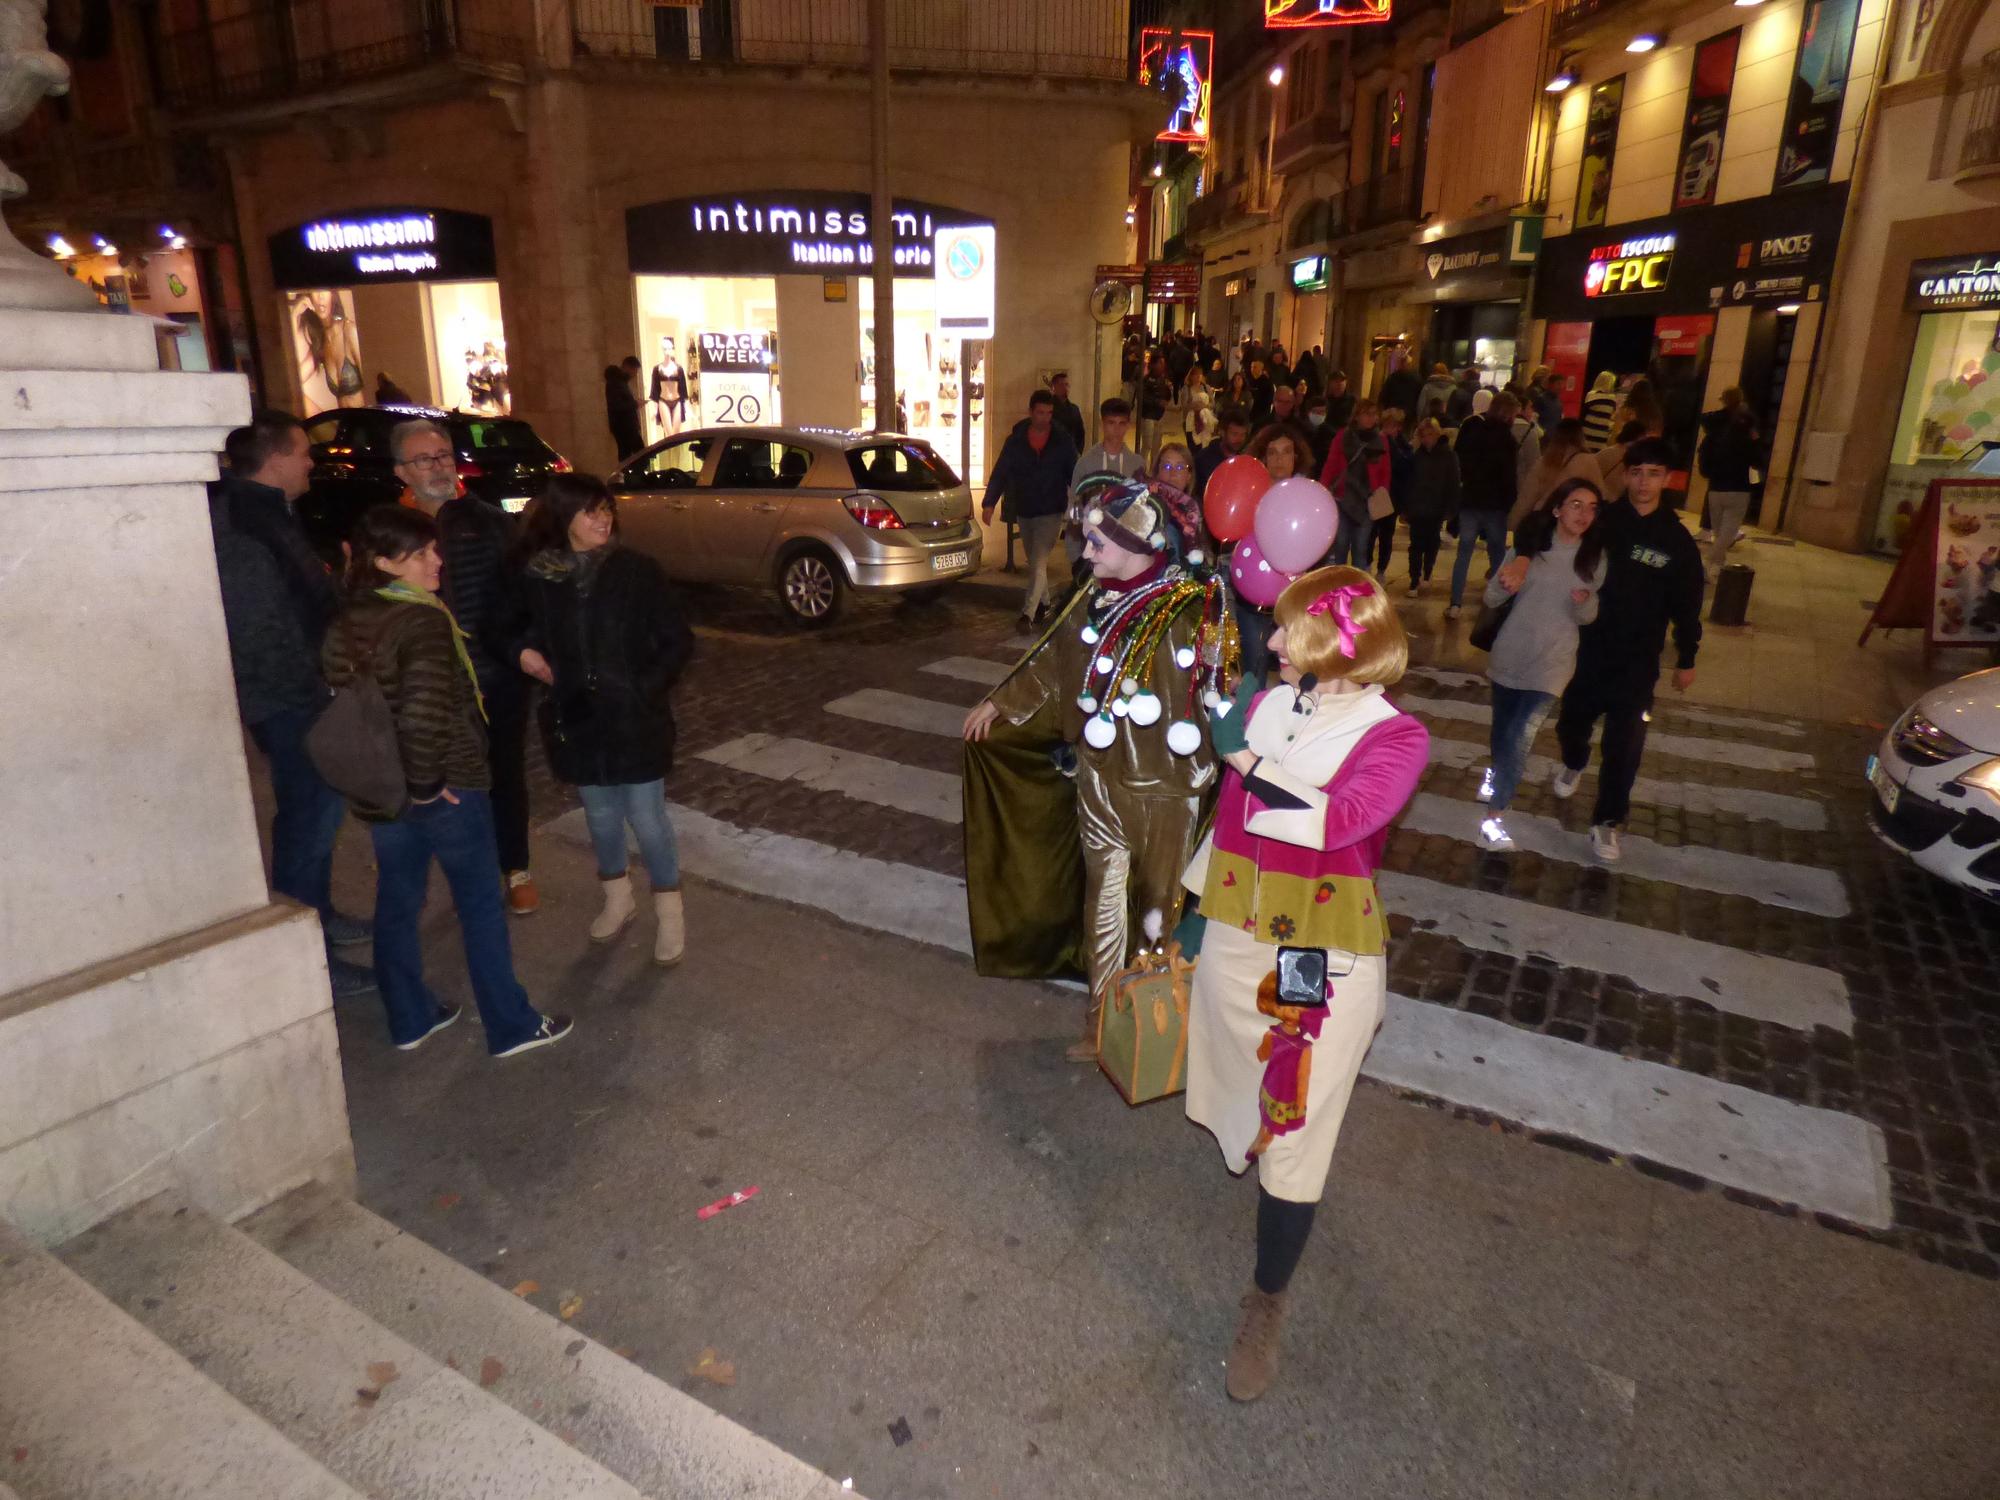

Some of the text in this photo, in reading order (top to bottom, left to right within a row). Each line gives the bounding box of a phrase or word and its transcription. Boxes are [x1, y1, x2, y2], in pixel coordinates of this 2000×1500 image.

[307, 218, 434, 251] intimissimi
[694, 203, 931, 237] intimissmi
[793, 242, 931, 264] Italian lierie
[1510, 220, 1536, 261] L
[1589, 234, 1675, 260] AUTOESCOLA
[1601, 256, 1664, 293] FPC
[702, 334, 764, 350] BLACK
[707, 349, 761, 363] WEEK
